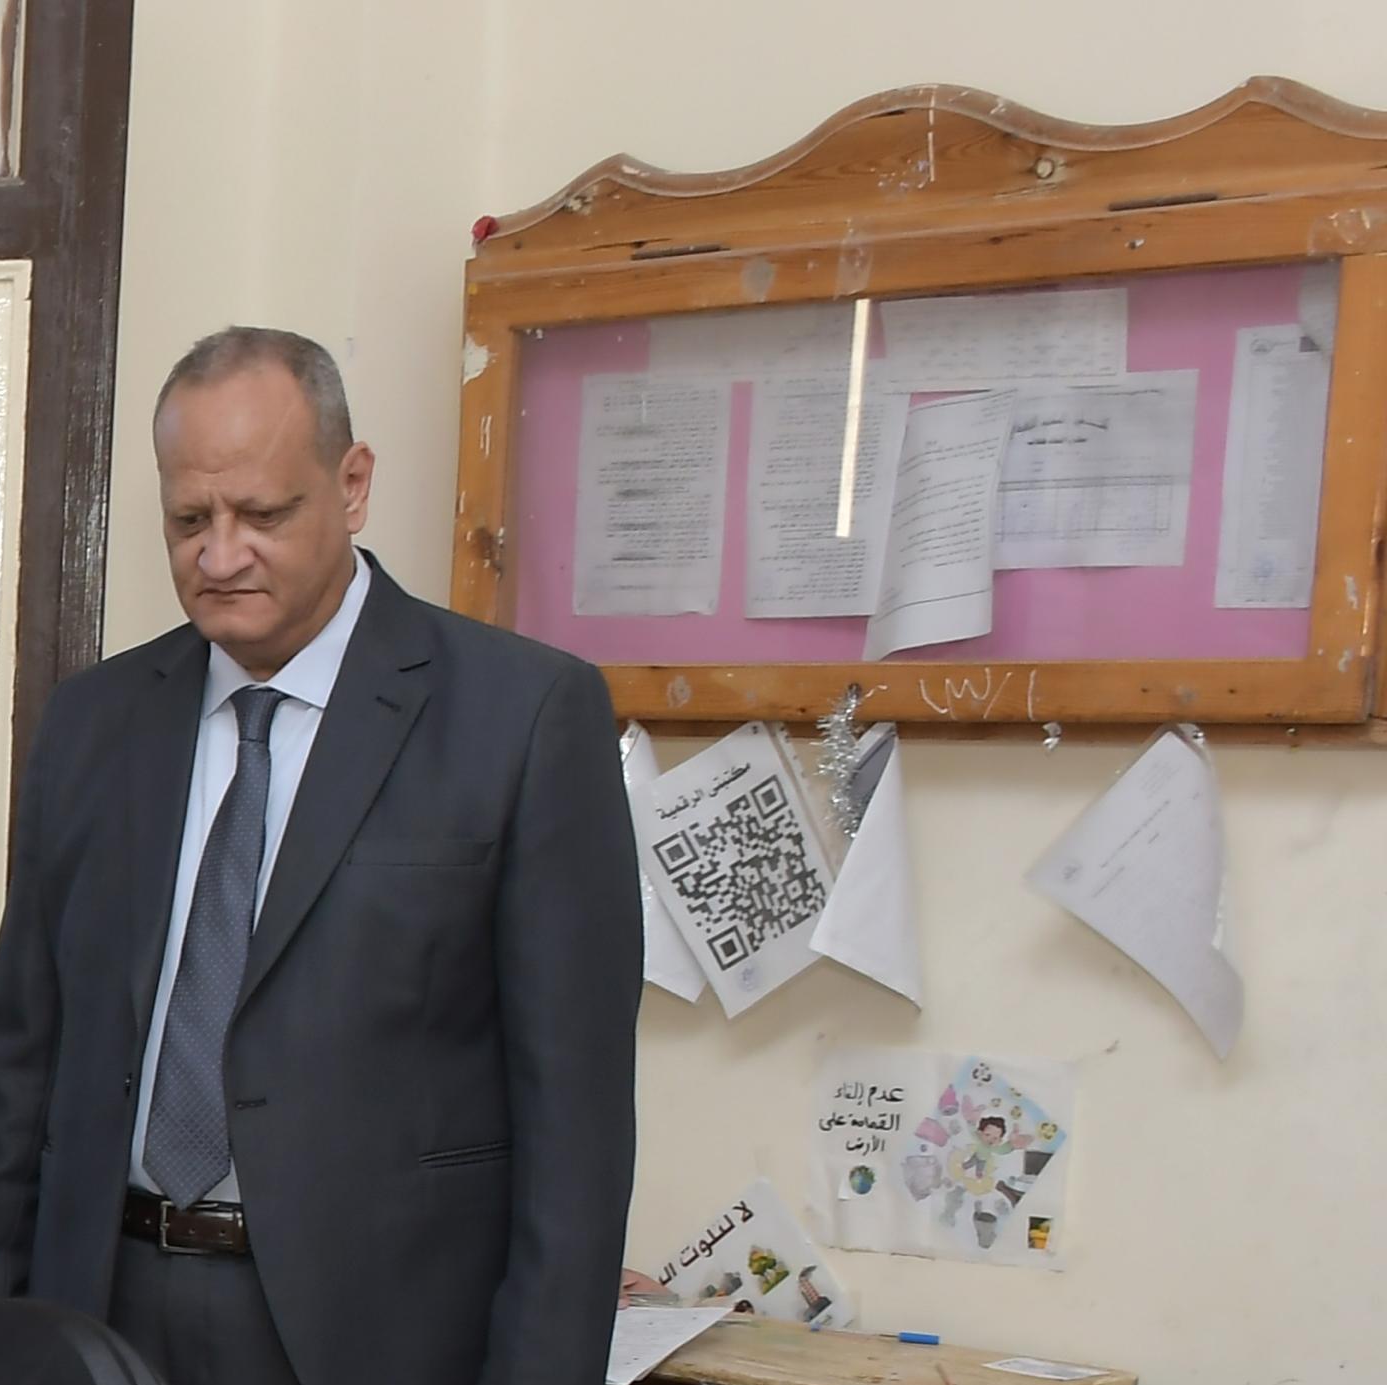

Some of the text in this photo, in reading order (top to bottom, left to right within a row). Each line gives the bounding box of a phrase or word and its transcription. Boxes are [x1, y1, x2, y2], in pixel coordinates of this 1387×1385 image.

[867, 1086, 905, 1107] عدم
[818, 1111, 847, 1132] على
[732, 1200, 755, 1223] لا
